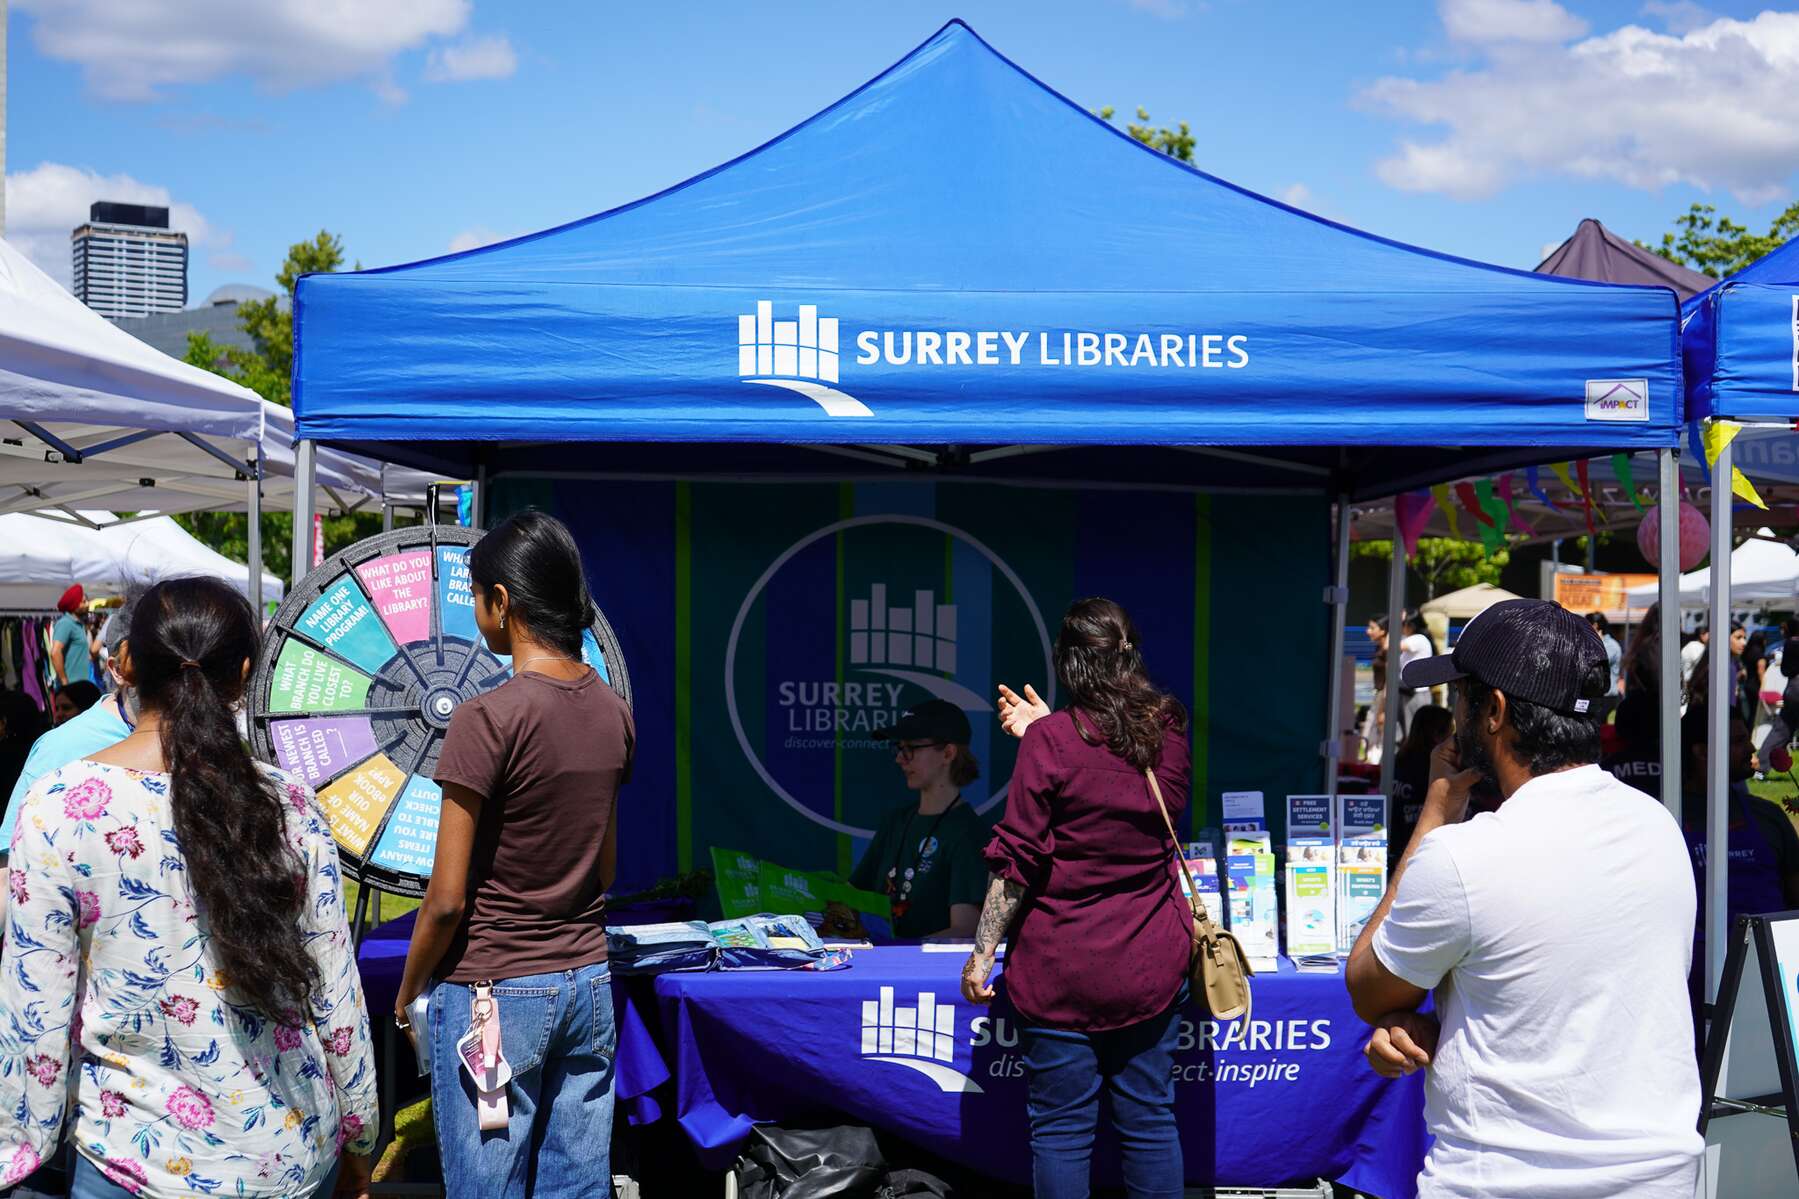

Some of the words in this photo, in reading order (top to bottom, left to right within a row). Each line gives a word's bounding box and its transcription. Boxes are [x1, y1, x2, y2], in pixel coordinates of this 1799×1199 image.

[856, 330, 1029, 365] SURREY
[1040, 332, 1249, 369] LIBRARIES
[361, 564, 389, 579] WHAT
[392, 560, 408, 572] DO
[410, 556, 430, 568] YOU
[371, 578, 393, 591] LIKE
[394, 570, 427, 586] ABOUT
[392, 587, 412, 599] THE
[447, 592, 476, 607] CALLE
[304, 603, 333, 628] NAME
[330, 585, 351, 606] ONE
[320, 599, 354, 633] LIBRARY
[383, 597, 428, 616] LIBRARY?
[325, 604, 369, 646] PROGRAM!
[280, 661, 296, 691] WHAT
[290, 668, 311, 710] BRANCH
[302, 651, 315, 666] DO
[307, 682, 320, 705] YOU
[315, 660, 328, 681] LIVE
[322, 666, 342, 707] CLOSEST
[339, 680, 353, 698] TO?
[779, 681, 905, 707] SURREY
[294, 724, 306, 735] IS
[789, 708, 898, 732] LIBRARI
[278, 725, 299, 765] NEWEST
[311, 729, 332, 766] CALLED
[299, 737, 320, 780] BRANCH
[405, 800, 440, 815] CHECK
[411, 788, 440, 801] OUT?
[341, 805, 370, 832] NAME
[394, 825, 417, 836] YOU
[398, 812, 413, 823] TO
[336, 823, 365, 850] WHAT
[398, 839, 430, 853] ITEMS
[380, 849, 414, 864] MANY
[1177, 1019, 1331, 1051] BRARIES
